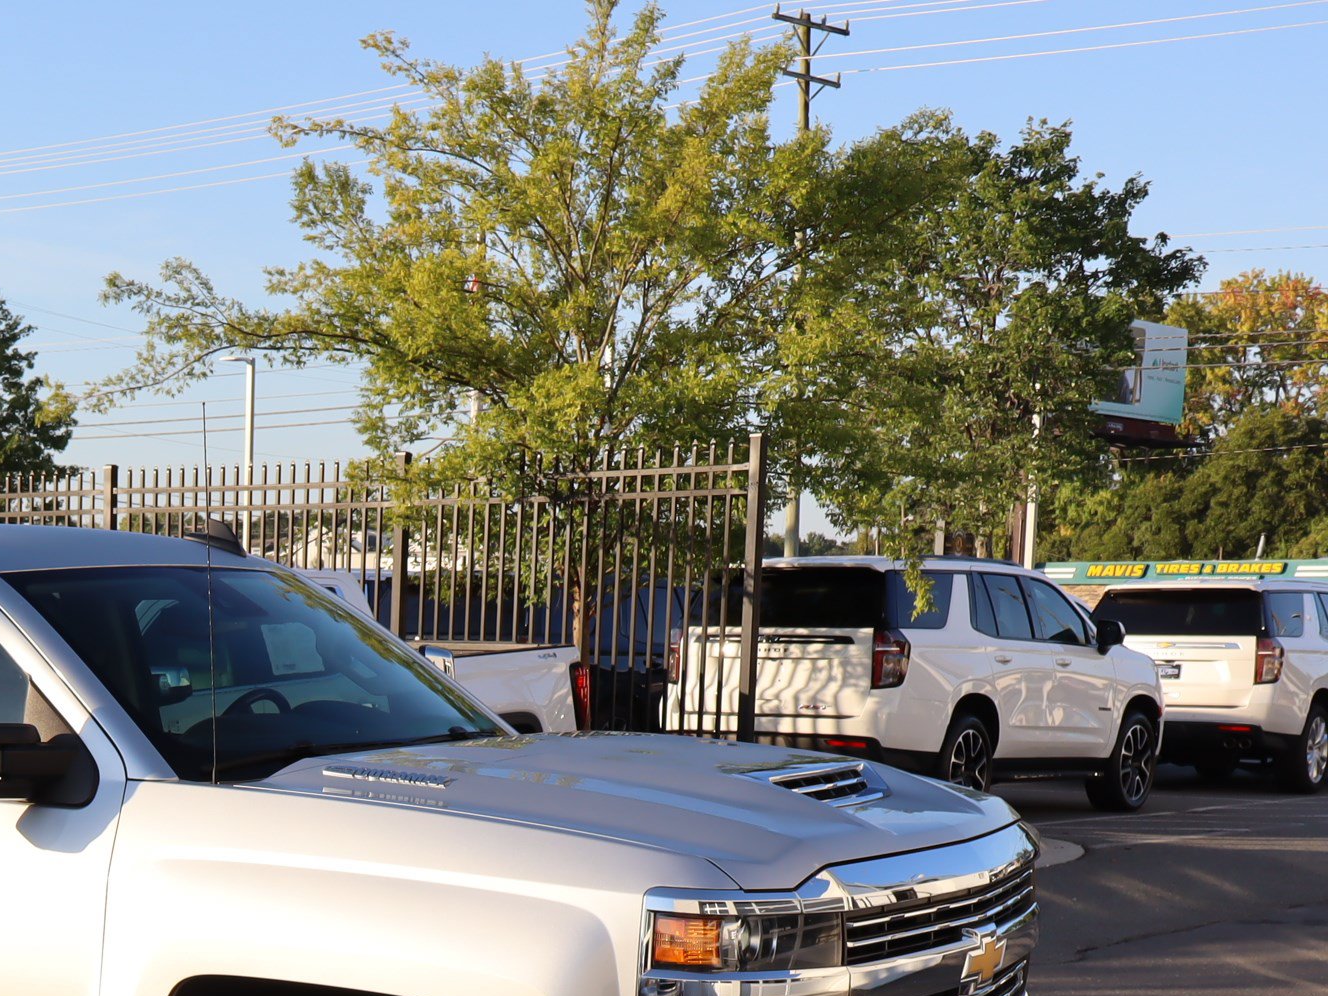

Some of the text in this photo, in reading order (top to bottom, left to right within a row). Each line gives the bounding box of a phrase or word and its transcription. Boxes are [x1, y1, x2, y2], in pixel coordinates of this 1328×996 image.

[1086, 563, 1147, 578] MAVIS
[1155, 562, 1203, 575] TIRES
[1216, 561, 1285, 575] BRAKES
